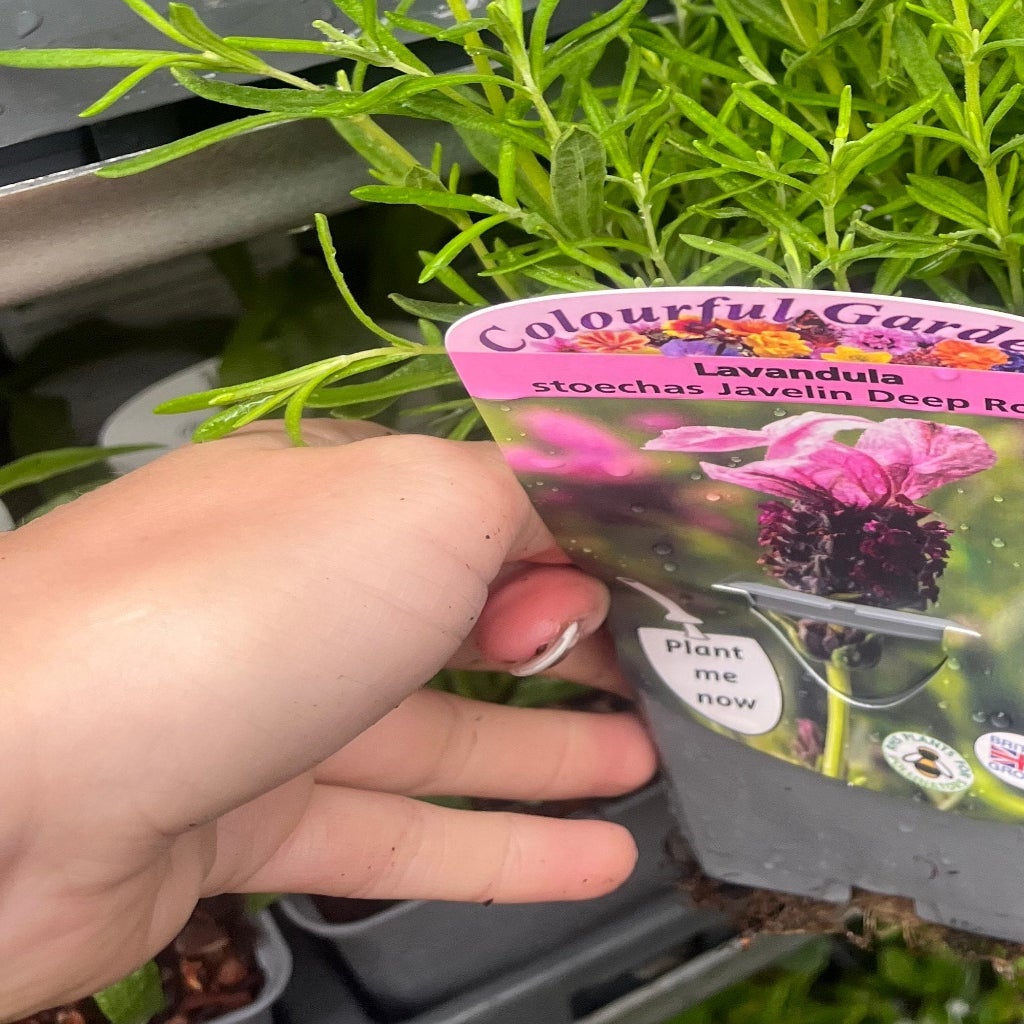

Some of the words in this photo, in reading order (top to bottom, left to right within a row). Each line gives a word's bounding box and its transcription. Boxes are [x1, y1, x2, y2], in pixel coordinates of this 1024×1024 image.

[479, 296, 798, 353] Colourful
[694, 362, 905, 386] Lavandula
[531, 379, 705, 396] stoechas
[717, 382, 853, 402] Javelin
[867, 389, 970, 412] Deep
[665, 639, 743, 660] Plant
[695, 668, 738, 683] me
[697, 693, 757, 710] now
